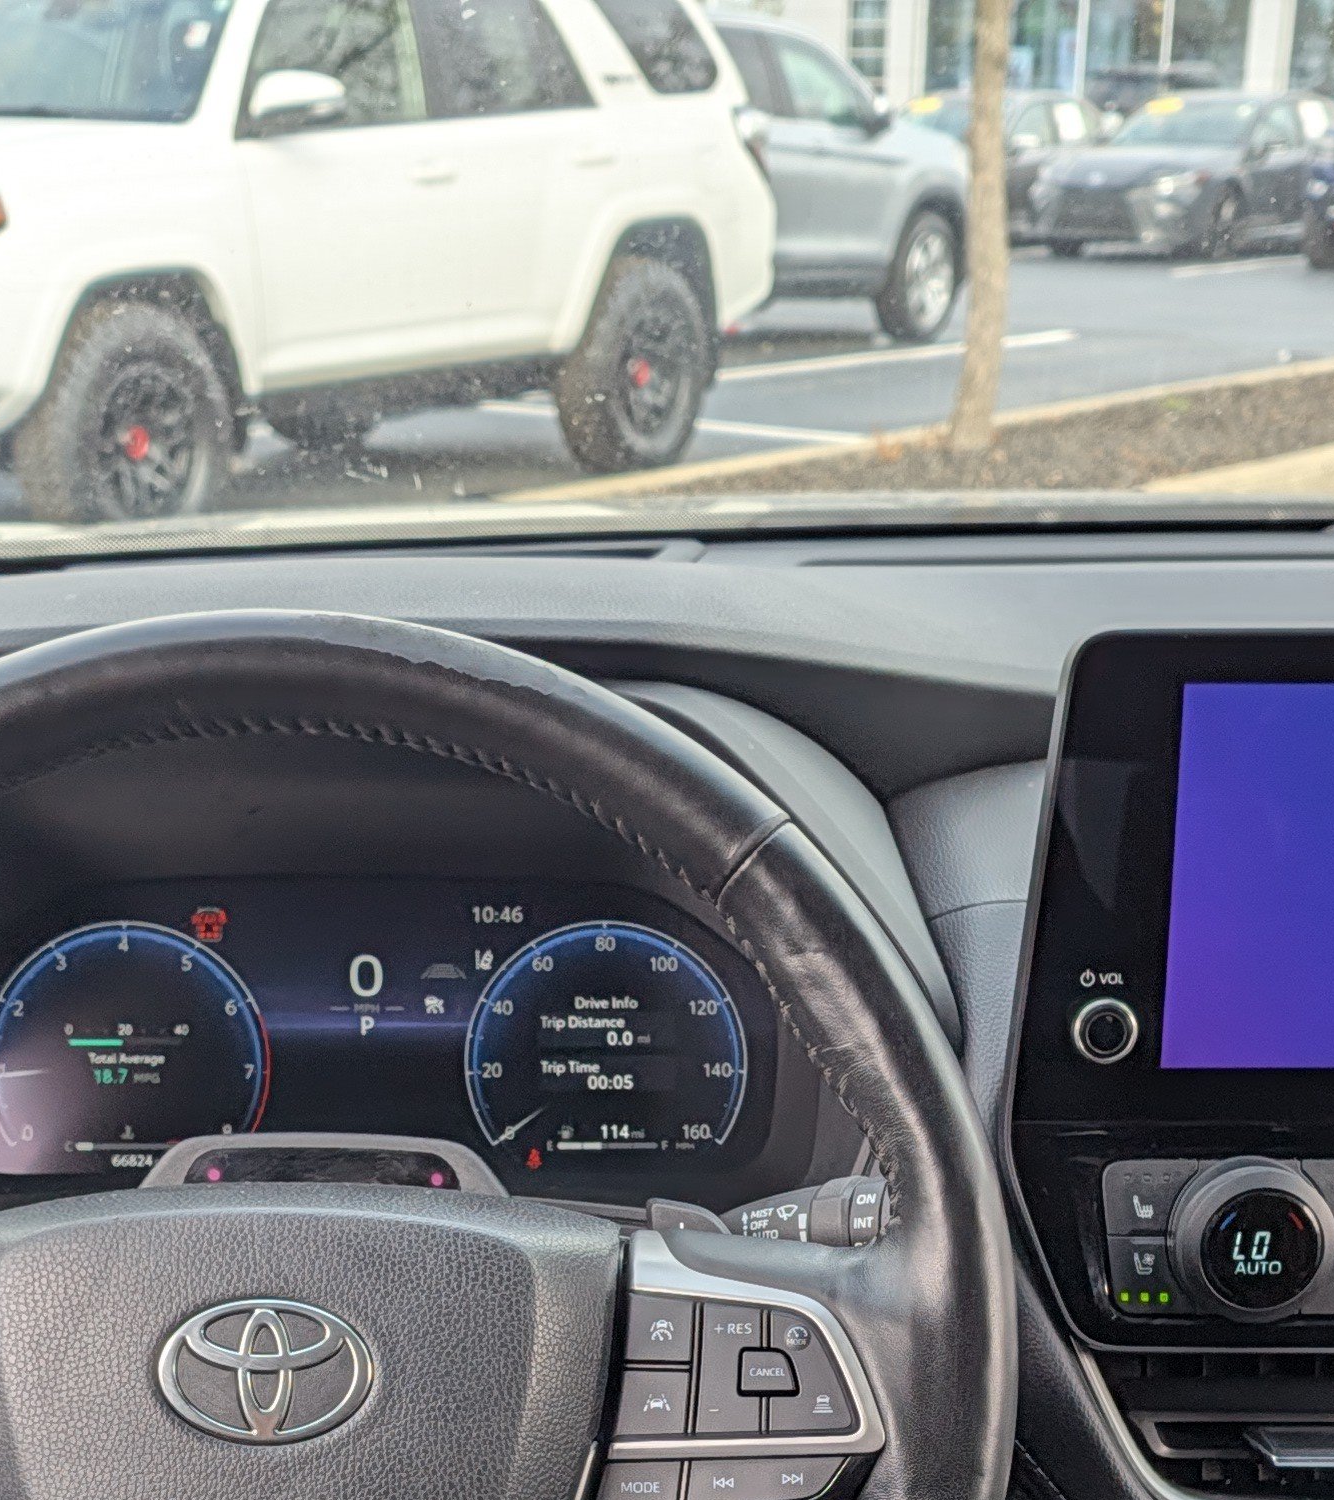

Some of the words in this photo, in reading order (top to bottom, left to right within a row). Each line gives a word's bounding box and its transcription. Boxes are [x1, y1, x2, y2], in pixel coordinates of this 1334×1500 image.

[472, 906, 523, 923] 10:46
[118, 937, 128, 951] 4
[595, 936, 615, 950] 80
[55, 953, 66, 970] 3
[181, 953, 192, 971] 5
[532, 956, 553, 971] 60
[650, 956, 677, 971] 100
[349, 954, 382, 996] 0
[1099, 973, 1123, 984] VOL
[13, 1001, 23, 1016] 2
[224, 1002, 237, 1015] 6
[492, 1000, 513, 1014] 40
[574, 996, 608, 1008] Drive
[612, 996, 638, 1009] Info
[689, 1000, 716, 1014] 120
[360, 1016, 374, 1035] P
[540, 1016, 564, 1029] Trip
[567, 1016, 624, 1028] Distance
[606, 1031, 633, 1045] 0.0
[244, 1063, 254, 1079] 7
[482, 1063, 502, 1077] 20
[540, 1059, 565, 1075] Trip
[569, 1060, 599, 1072] Time
[703, 1063, 732, 1077] 140
[93, 1068, 127, 1083] 18.7
[587, 1074, 633, 1089] 00:05
[600, 1124, 629, 1139] 114
[682, 1124, 711, 1140] 160
[856, 1193, 876, 1205] ON
[751, 1207, 774, 1218] MIST
[751, 1220, 768, 1230] OFF
[853, 1216, 874, 1229] INT
[1233, 1261, 1282, 1274] AUTO
[749, 1366, 785, 1377] CANCEL
[620, 1481, 660, 1494] MODE
